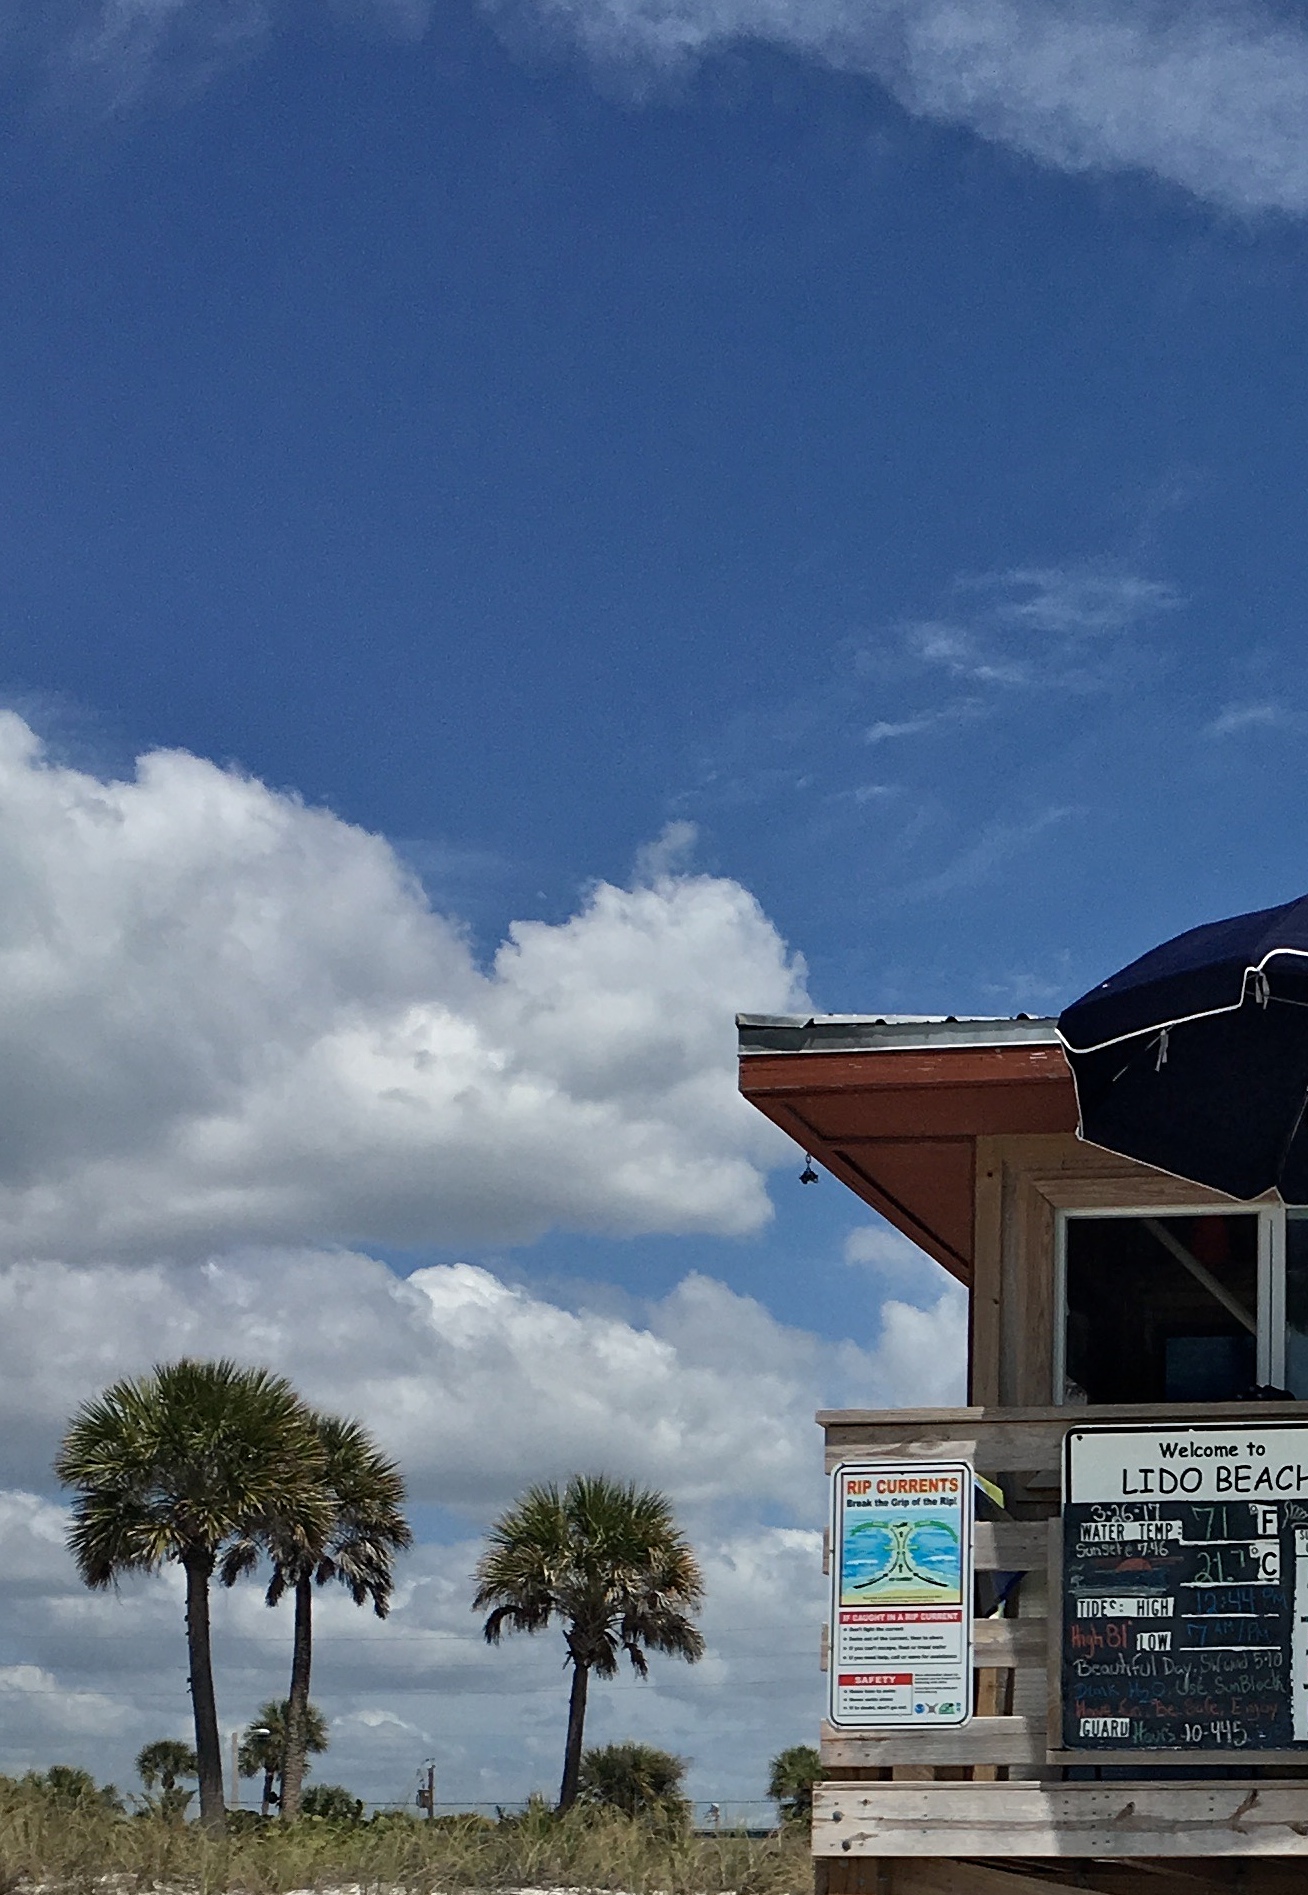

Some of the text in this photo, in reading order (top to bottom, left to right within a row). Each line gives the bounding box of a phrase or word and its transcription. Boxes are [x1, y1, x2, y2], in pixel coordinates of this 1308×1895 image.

[1159, 1442, 1266, 1459] Welcome to
[847, 1478, 959, 1495] RIP CURRENTS
[1122, 1467, 1203, 1495] LIDO
[846, 1499, 872, 1508] Break
[875, 1498, 889, 1507] the
[891, 1498, 910, 1508] Grip
[912, 1497, 921, 1506] of
[923, 1497, 938, 1506] the
[1091, 1503, 1160, 1522] 3-26-17
[1081, 1522, 1182, 1541] WATER TEMP:
[1137, 1599, 1169, 1616] HIGH
[1138, 1633, 1169, 1651] LOW
[854, 1675, 896, 1684] SAFETY
[1082, 1719, 1128, 1737] GUARD
